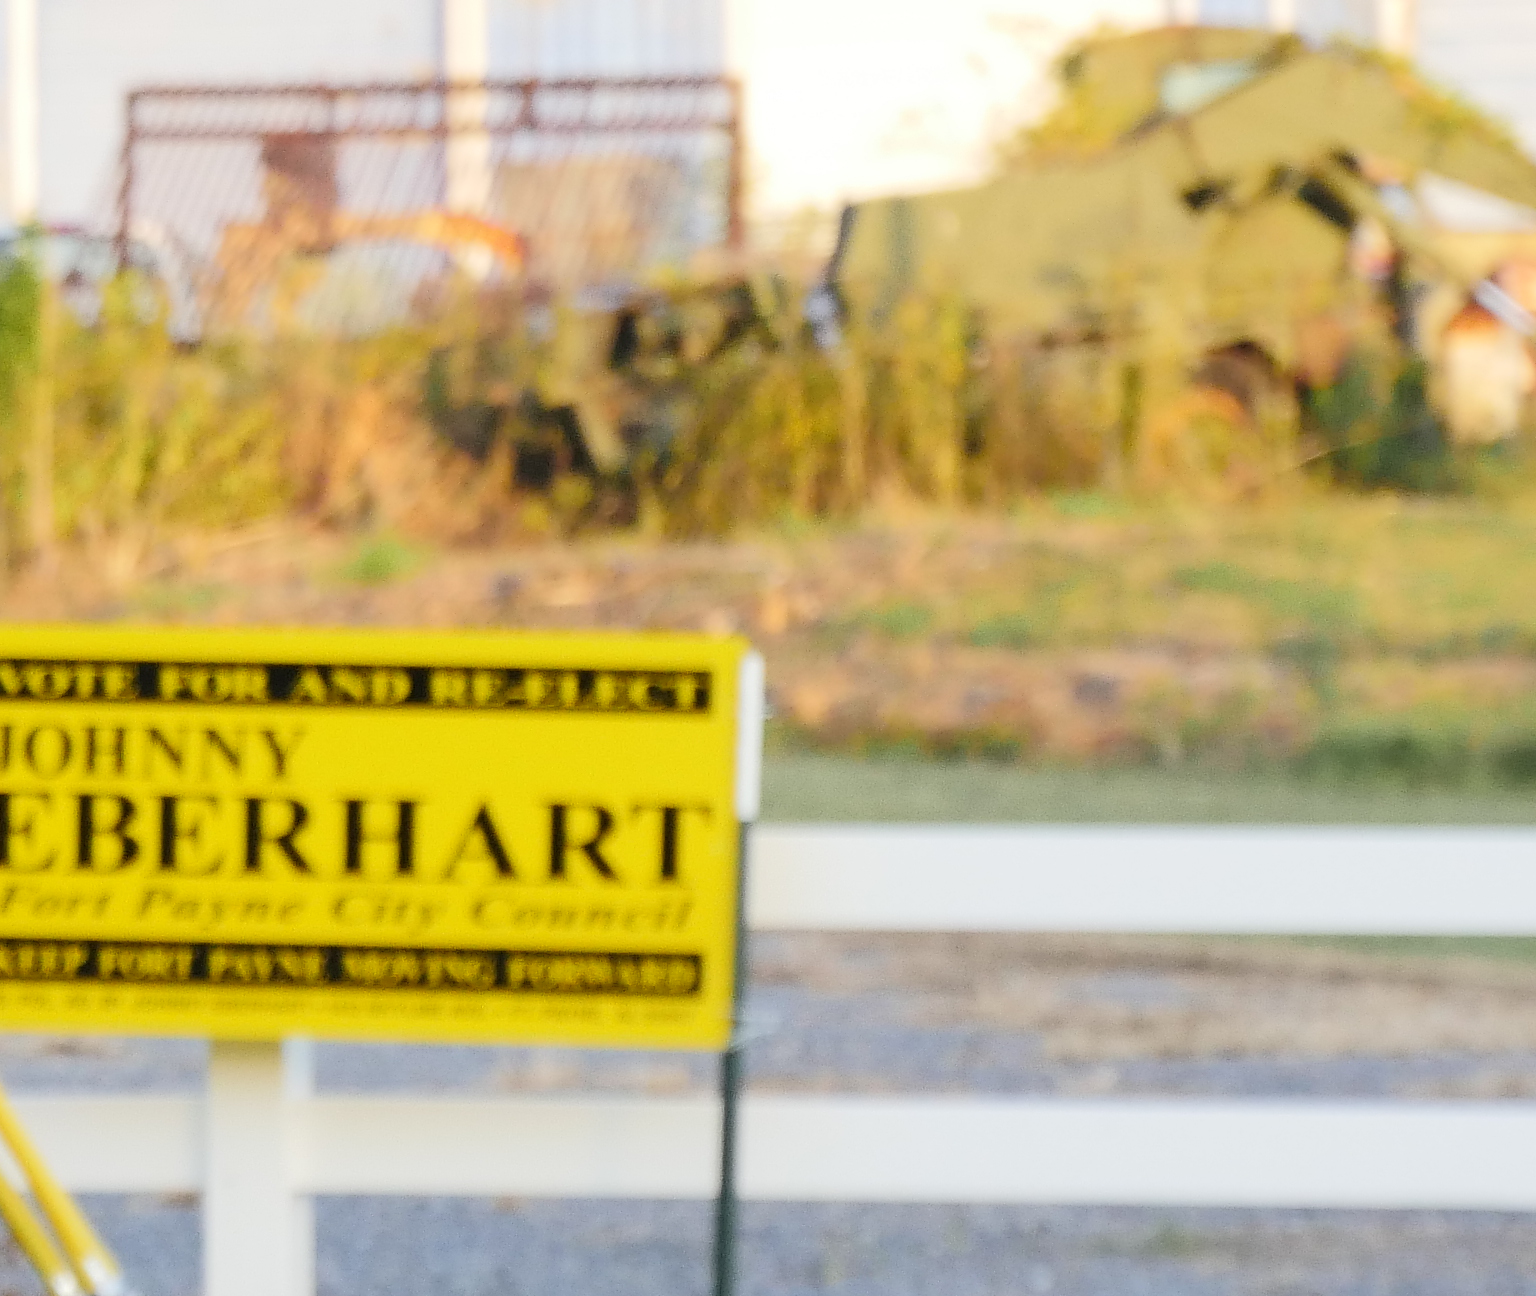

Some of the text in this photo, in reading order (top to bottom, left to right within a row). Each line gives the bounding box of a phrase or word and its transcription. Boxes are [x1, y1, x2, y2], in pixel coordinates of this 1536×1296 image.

[160, 663, 267, 704] FOR
[292, 665, 411, 705] AND
[136, 887, 302, 931] Payne
[333, 895, 441, 935] City
[472, 896, 695, 932] Council
[99, 944, 191, 981] FORT
[208, 946, 325, 985] PAYNE
[508, 953, 697, 994] FORWARD
